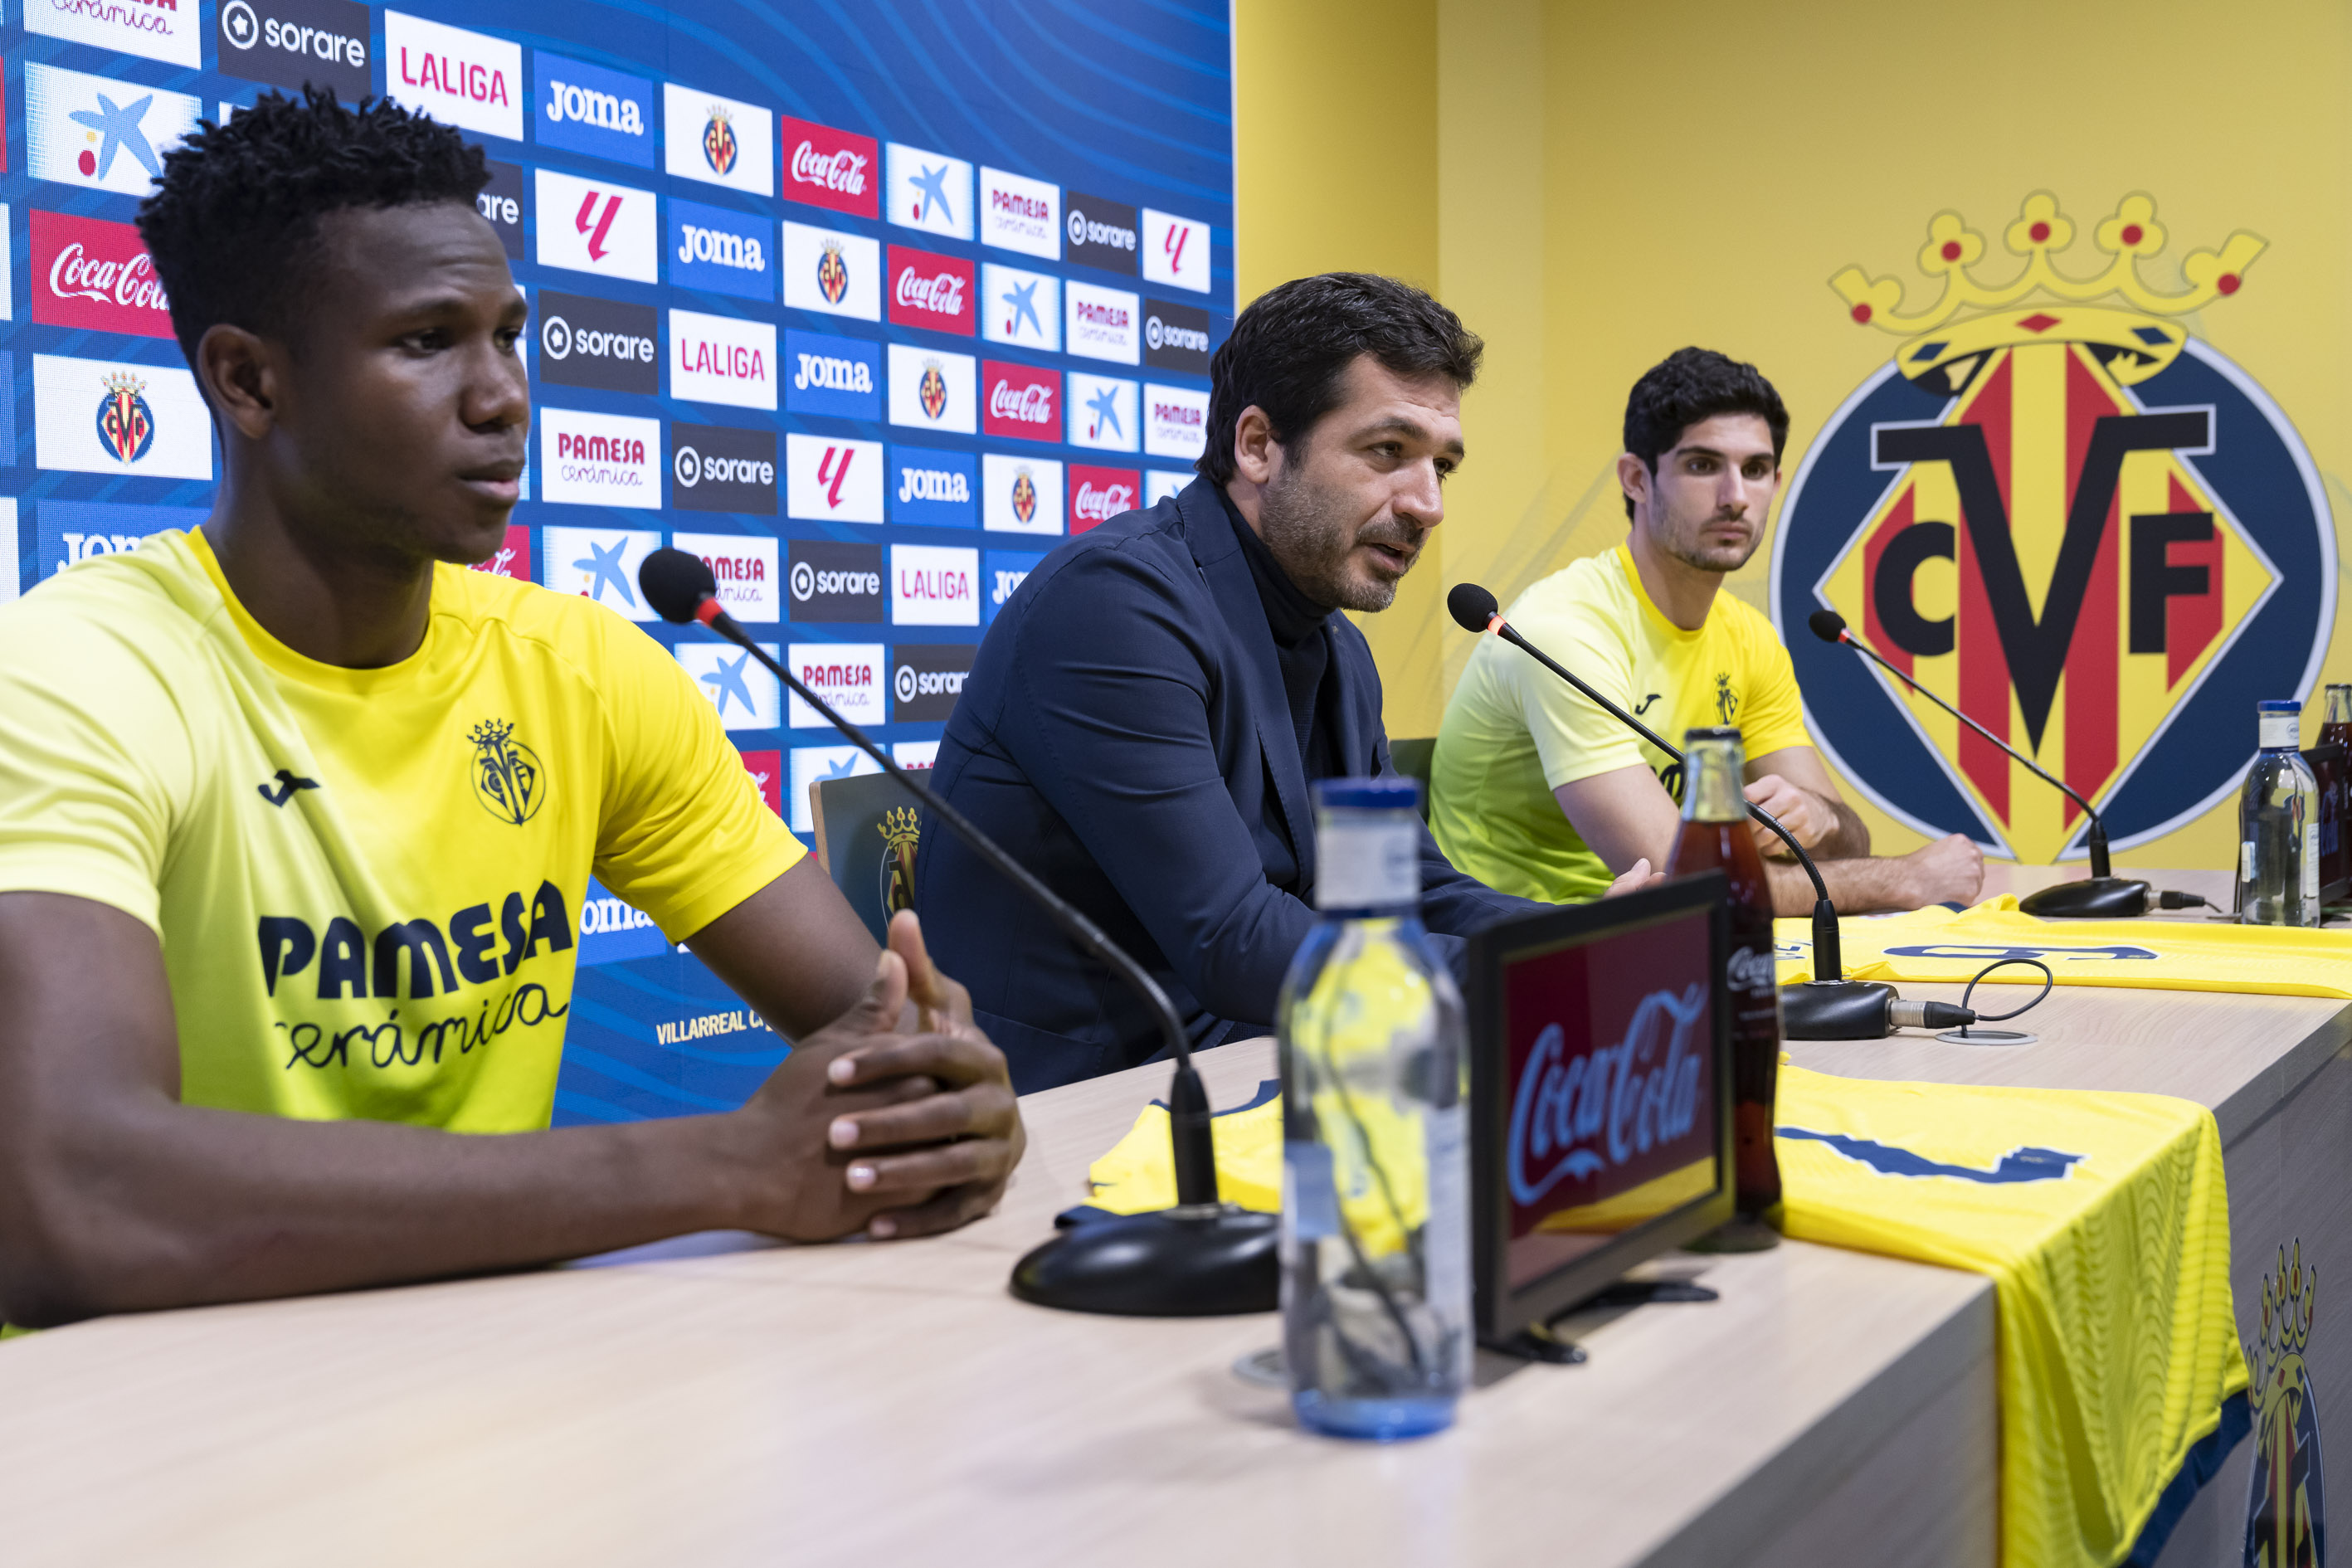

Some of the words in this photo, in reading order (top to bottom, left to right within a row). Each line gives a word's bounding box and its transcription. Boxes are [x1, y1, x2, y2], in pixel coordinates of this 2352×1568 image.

[265, 17, 365, 67] sorare
[402, 46, 508, 107] LALIGA
[476, 192, 519, 224] are
[1087, 220, 1136, 251] sorare
[576, 328, 655, 363] sorare
[1163, 325, 1209, 352] sorare
[681, 338, 765, 381] LALIGA
[558, 432, 644, 465] PAMESA
[704, 456, 773, 485] sorare
[702, 556, 764, 581] MESA
[816, 570, 880, 595] sorare
[901, 570, 969, 599] LALIGA
[803, 665, 871, 686] PAMESA
[918, 672, 969, 695] sorar
[580, 897, 655, 935] oma
[258, 879, 572, 1000] PAMESA
[656, 1010, 747, 1045] VILLARREAL
